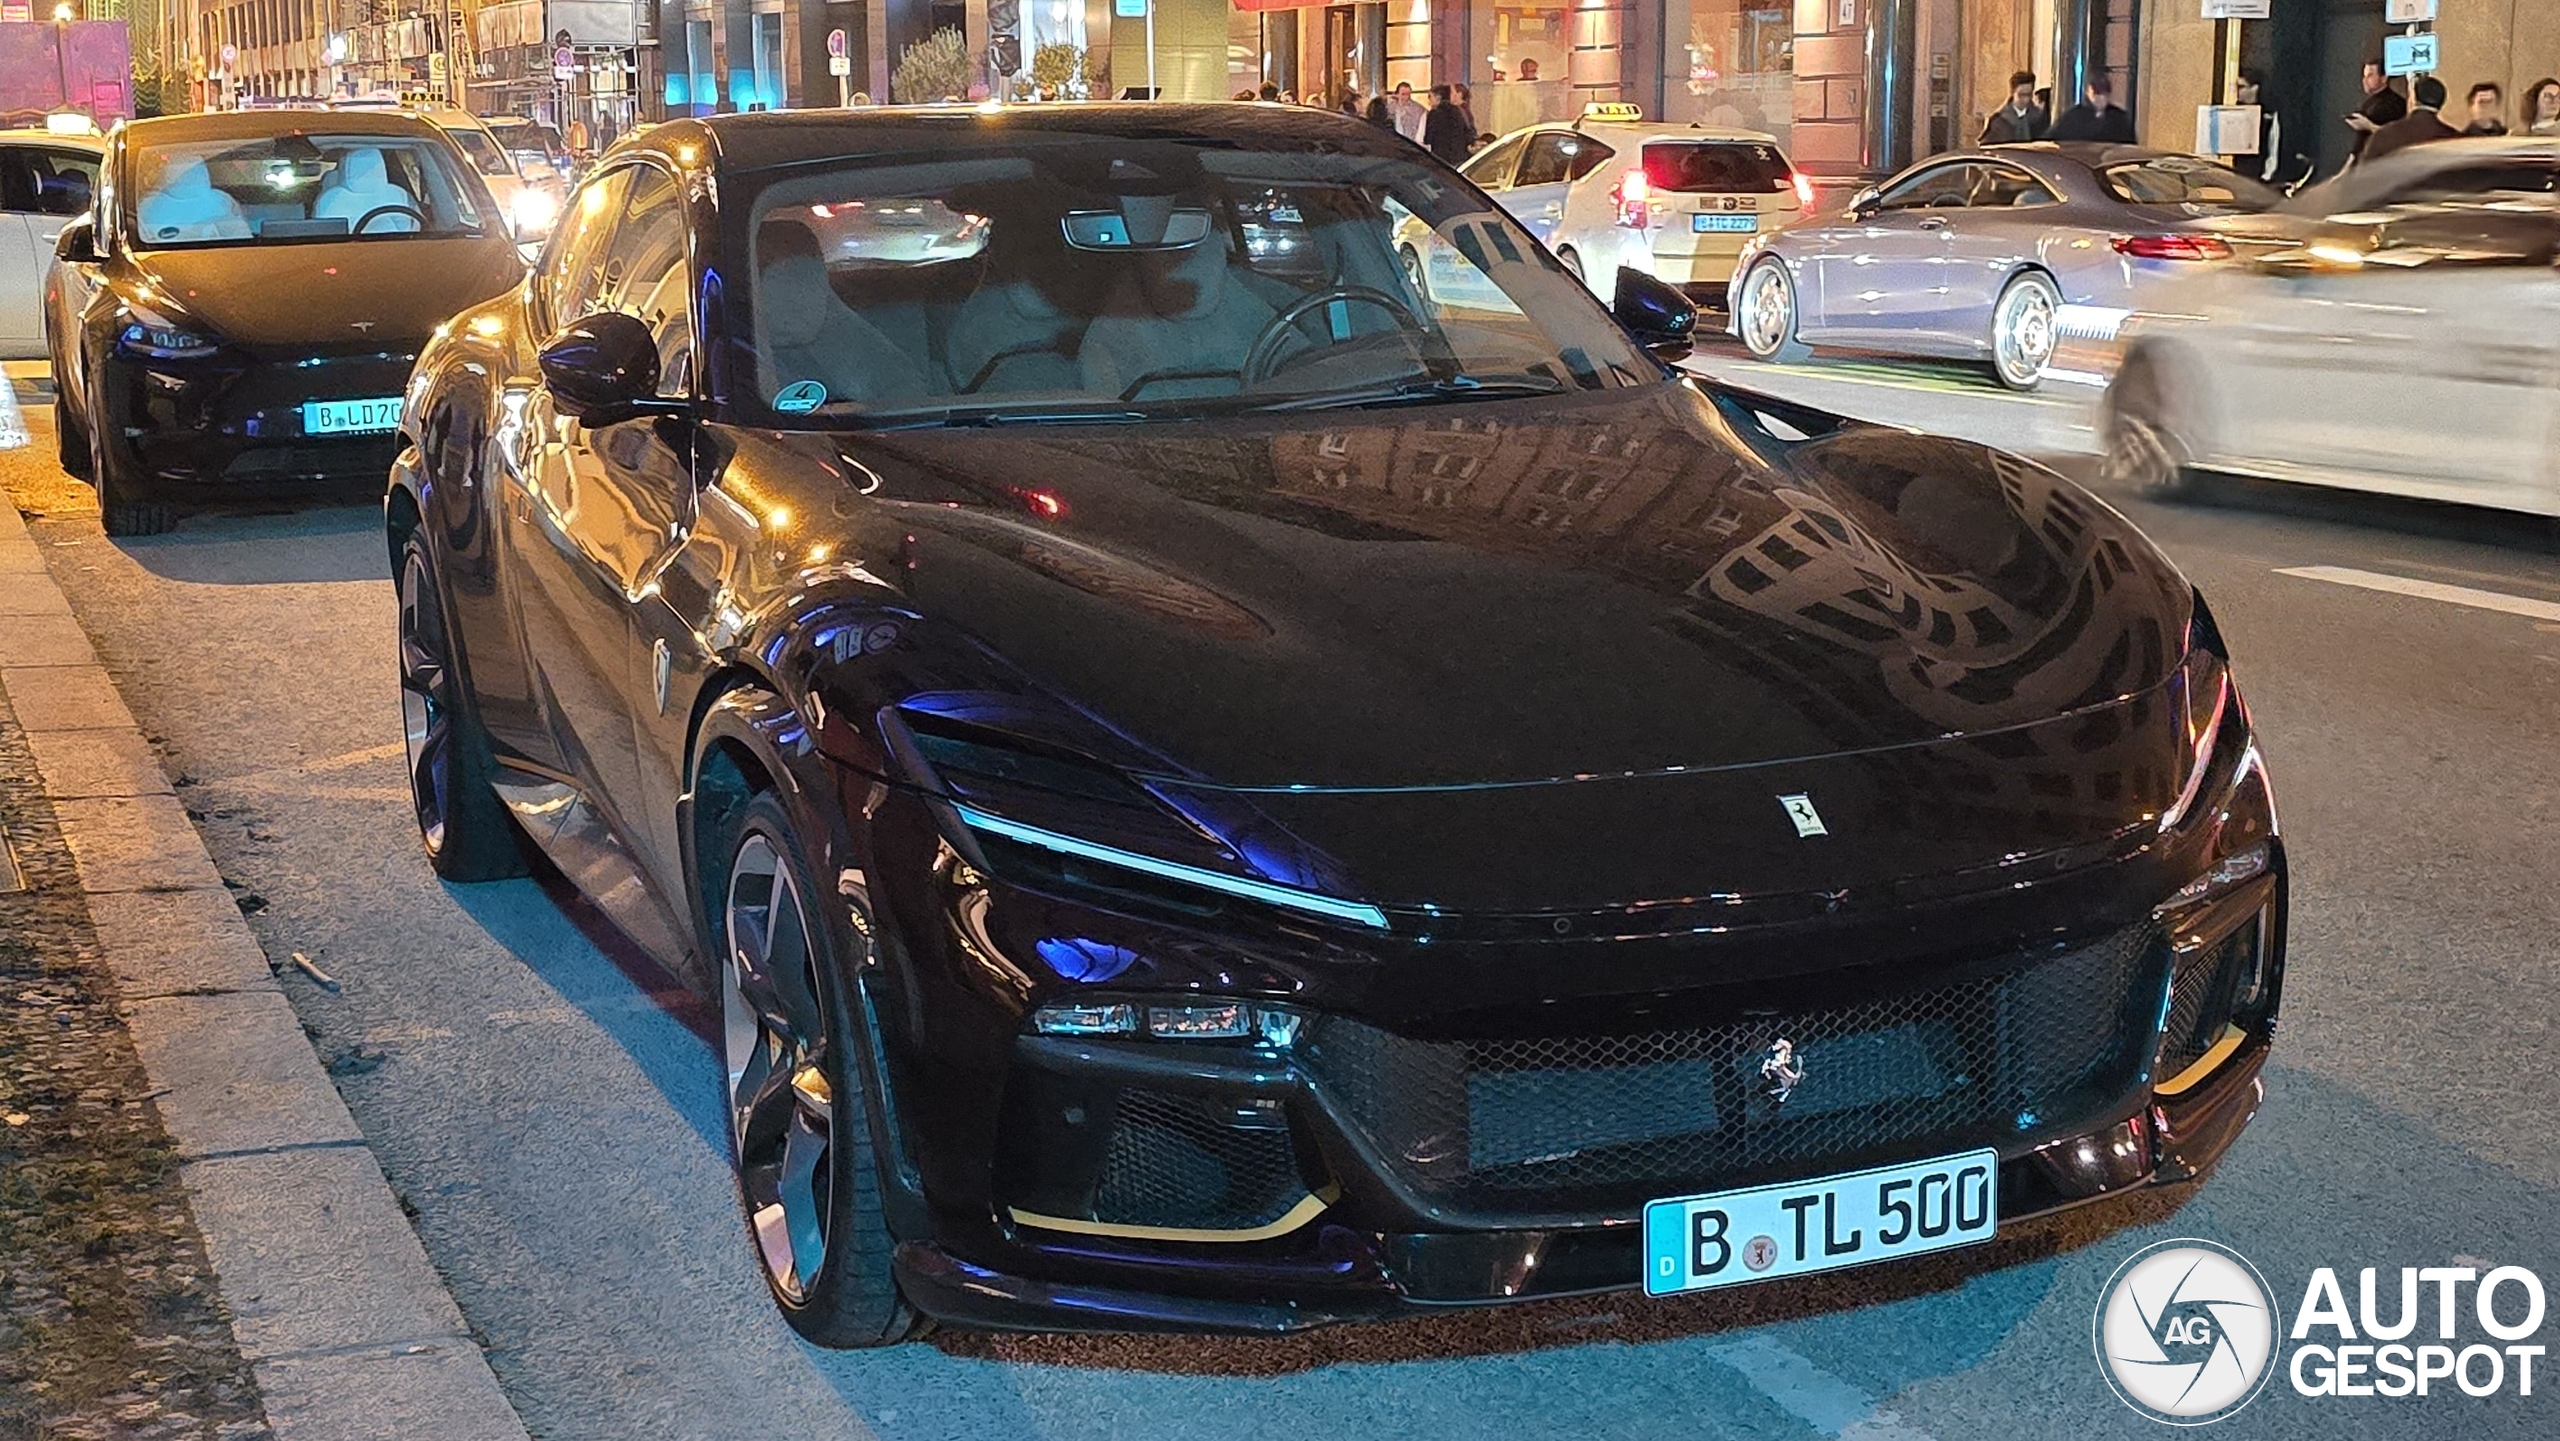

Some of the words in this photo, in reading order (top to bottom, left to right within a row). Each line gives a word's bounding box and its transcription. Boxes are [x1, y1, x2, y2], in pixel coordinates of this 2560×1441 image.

[794, 383, 811, 399] 4
[320, 407, 332, 427] B
[1659, 1256, 1675, 1277] D
[1692, 1209, 1731, 1276] B
[1781, 1192, 1862, 1261] TL
[1879, 1165, 1989, 1245] 500
